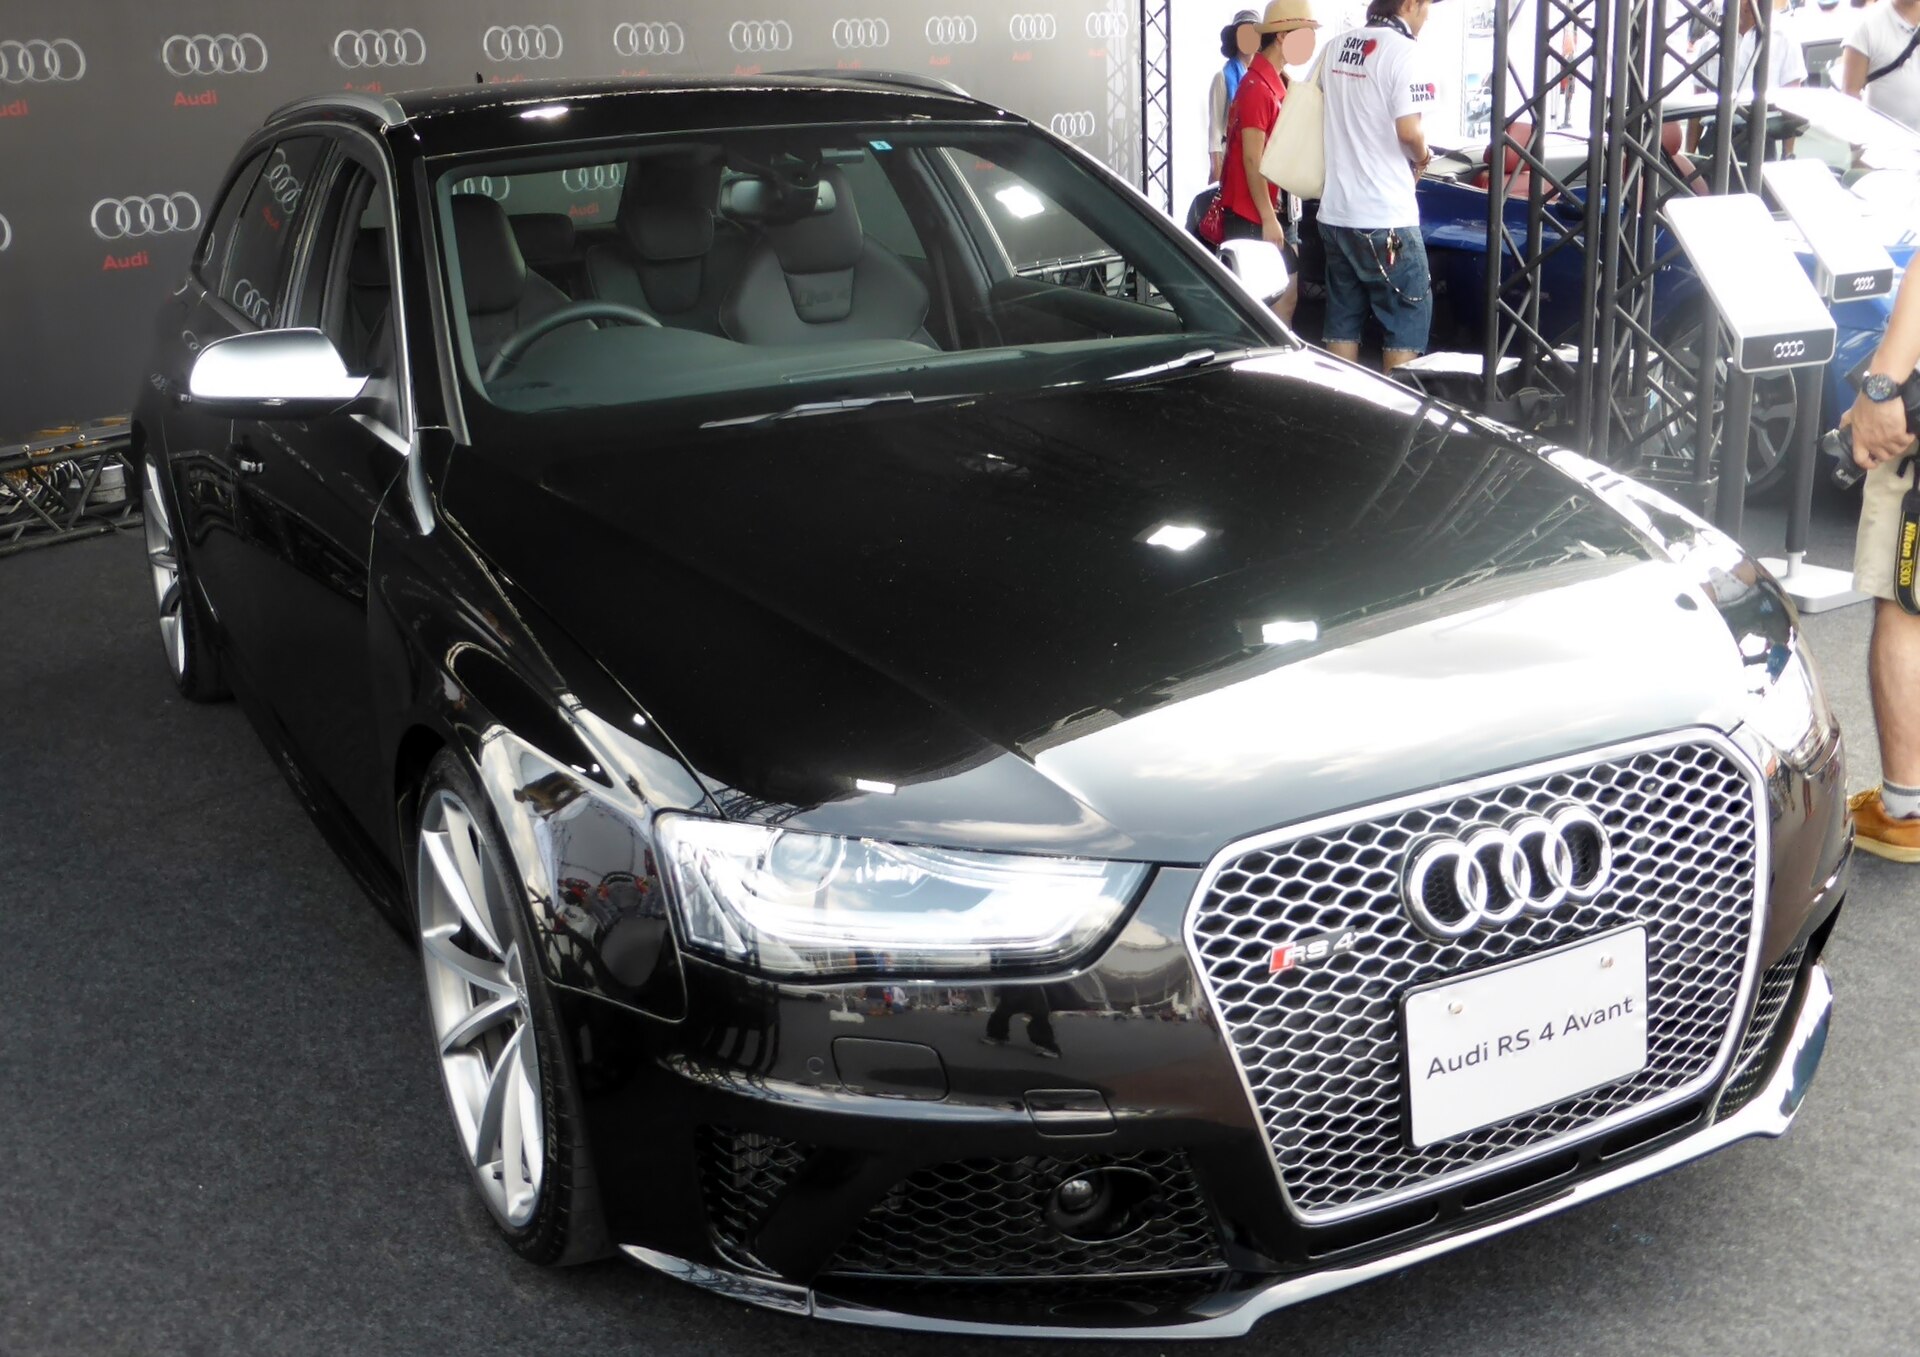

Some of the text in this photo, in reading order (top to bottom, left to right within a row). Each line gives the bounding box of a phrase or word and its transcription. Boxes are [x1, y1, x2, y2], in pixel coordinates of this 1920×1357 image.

[1343, 37, 1369, 51] SAVE
[1409, 83, 1431, 92] SAVE
[174, 90, 217, 106] Audi
[0, 100, 29, 117] udi
[103, 252, 149, 270] Audi
[1902, 521, 1917, 558] Nikon
[1427, 997, 1634, 1079] Audi RS 4 Avant
